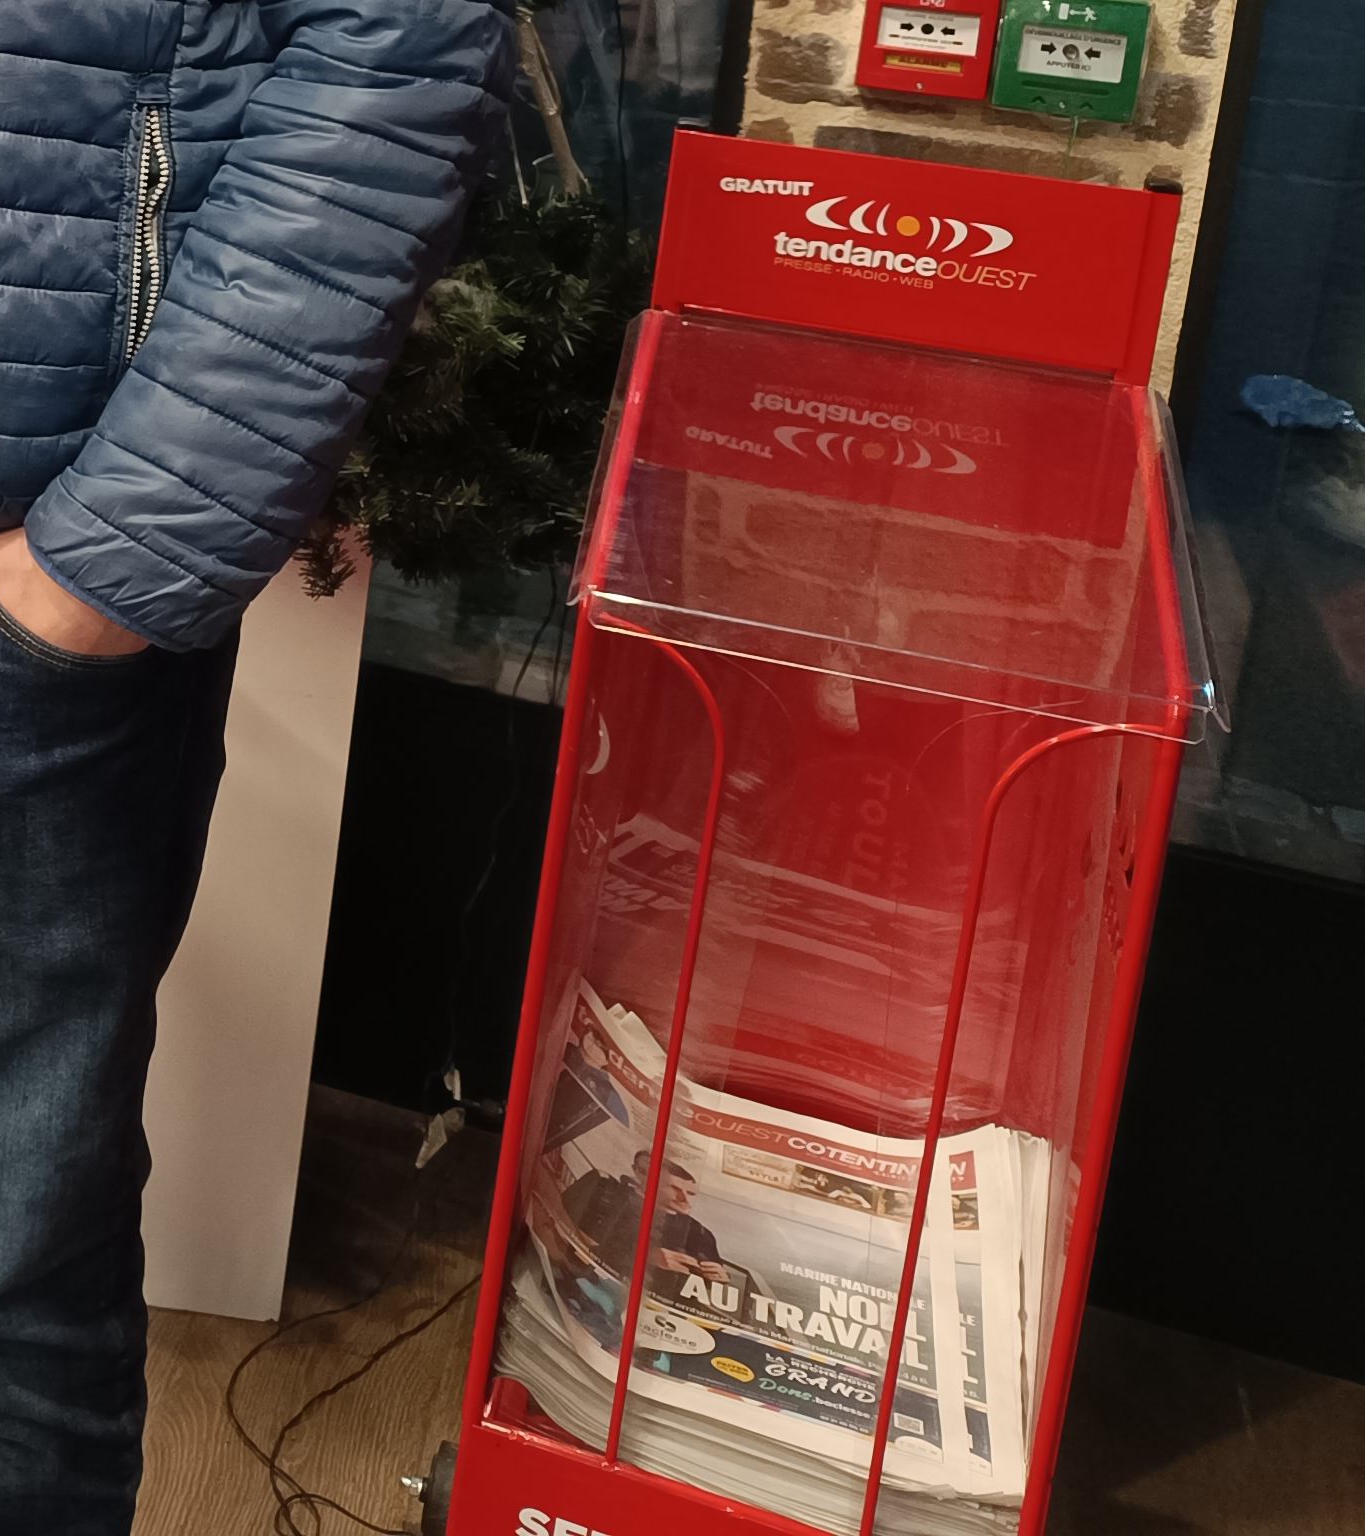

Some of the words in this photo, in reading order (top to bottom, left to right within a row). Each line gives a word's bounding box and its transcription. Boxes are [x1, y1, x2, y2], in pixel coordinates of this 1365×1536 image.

[719, 176, 814, 198] GRATUIT
[842, 267, 890, 284] RADIO
[898, 274, 934, 291] WEB
[680, 1273, 739, 1313] AU
[780, 1262, 838, 1285] MARINE
[840, 1277, 926, 1311] NATIONLE
[764, 1363, 876, 1404] GRAND
